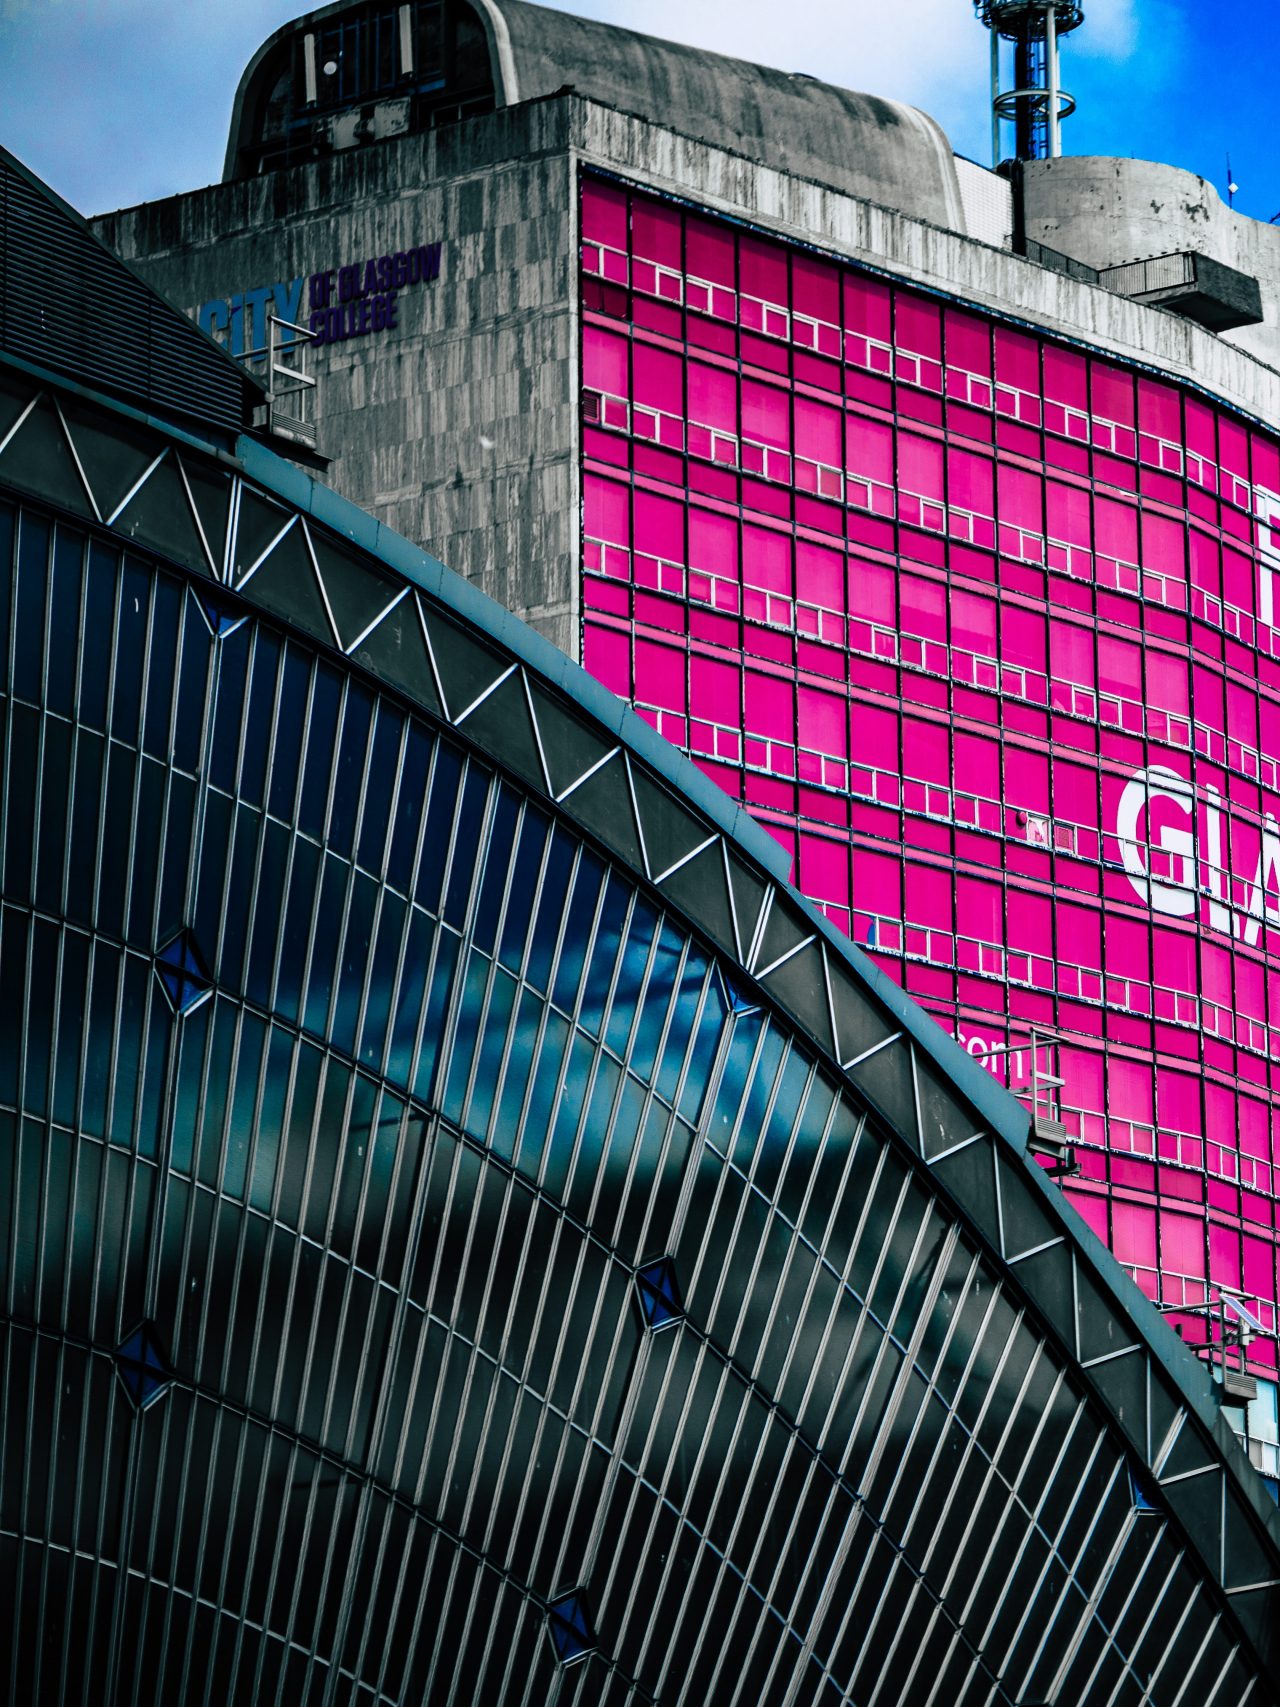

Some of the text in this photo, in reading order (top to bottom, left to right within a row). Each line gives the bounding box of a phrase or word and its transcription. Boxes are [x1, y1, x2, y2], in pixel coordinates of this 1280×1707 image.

[309, 242, 442, 310] OF GLASGOW
[200, 276, 304, 363] CITY
[309, 291, 398, 348] COLLEGE
